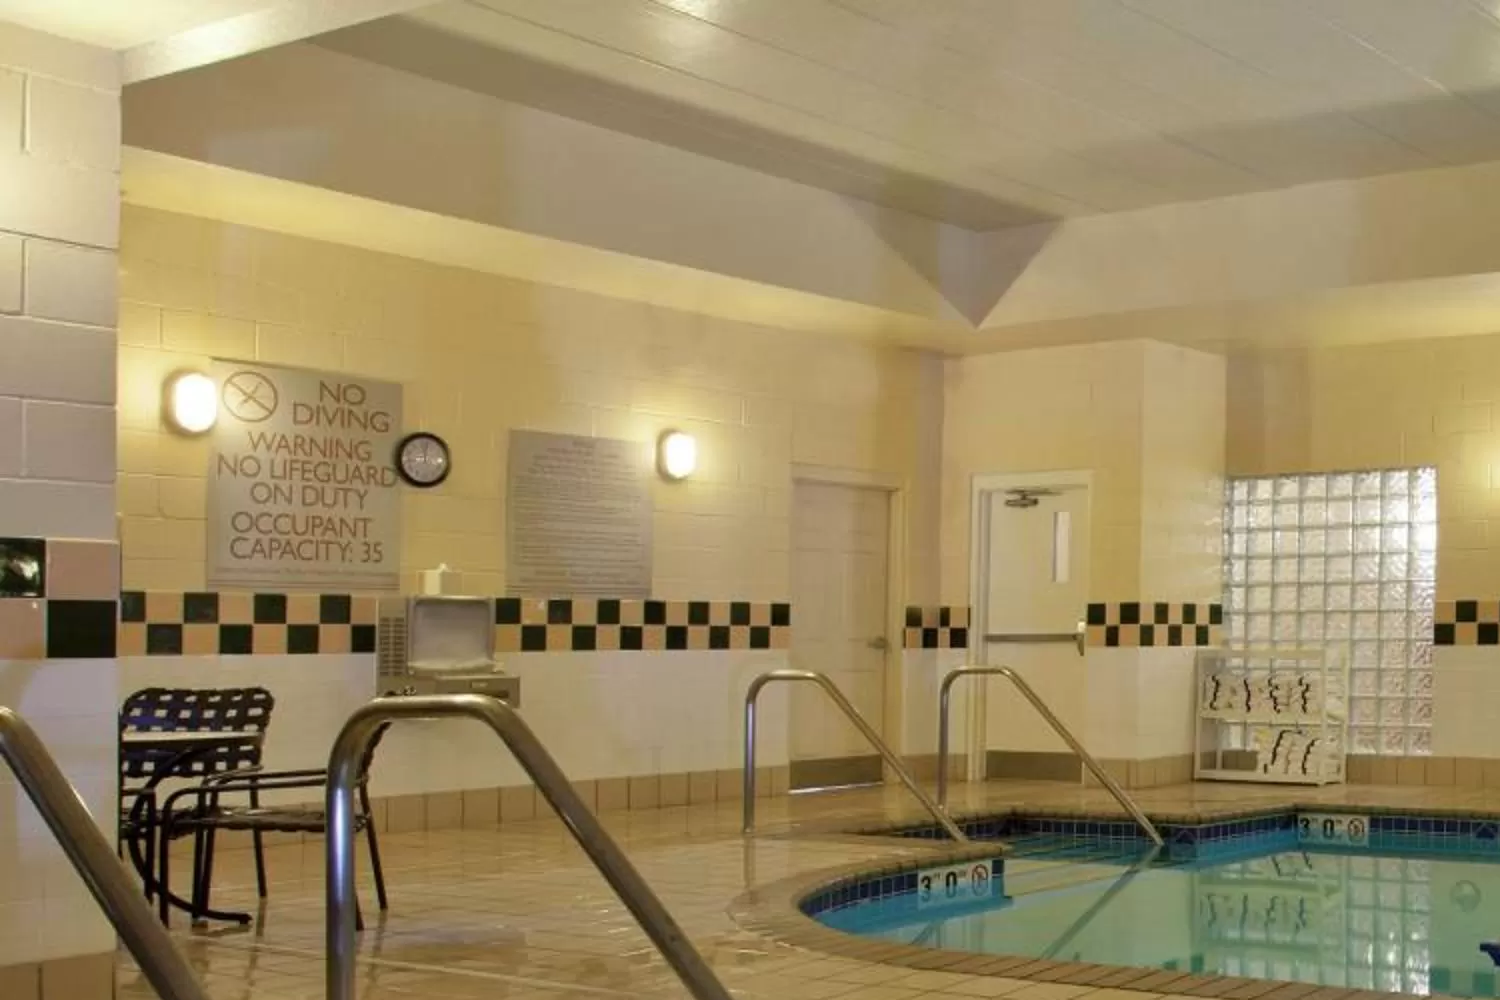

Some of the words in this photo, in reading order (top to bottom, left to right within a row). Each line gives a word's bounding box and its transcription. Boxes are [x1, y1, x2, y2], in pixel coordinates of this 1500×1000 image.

[318, 380, 367, 406] NO
[292, 402, 391, 433] DIVING
[248, 431, 373, 462] WARNING
[217, 452, 262, 478] NO
[270, 459, 397, 488] LIFEGUARD
[250, 482, 293, 505] ON
[301, 484, 369, 511] DUTY
[231, 511, 375, 538] OCCUPANT
[229, 536, 353, 562] CAPACITY:
[360, 541, 384, 563] 35
[945, 871, 957, 898] 0
